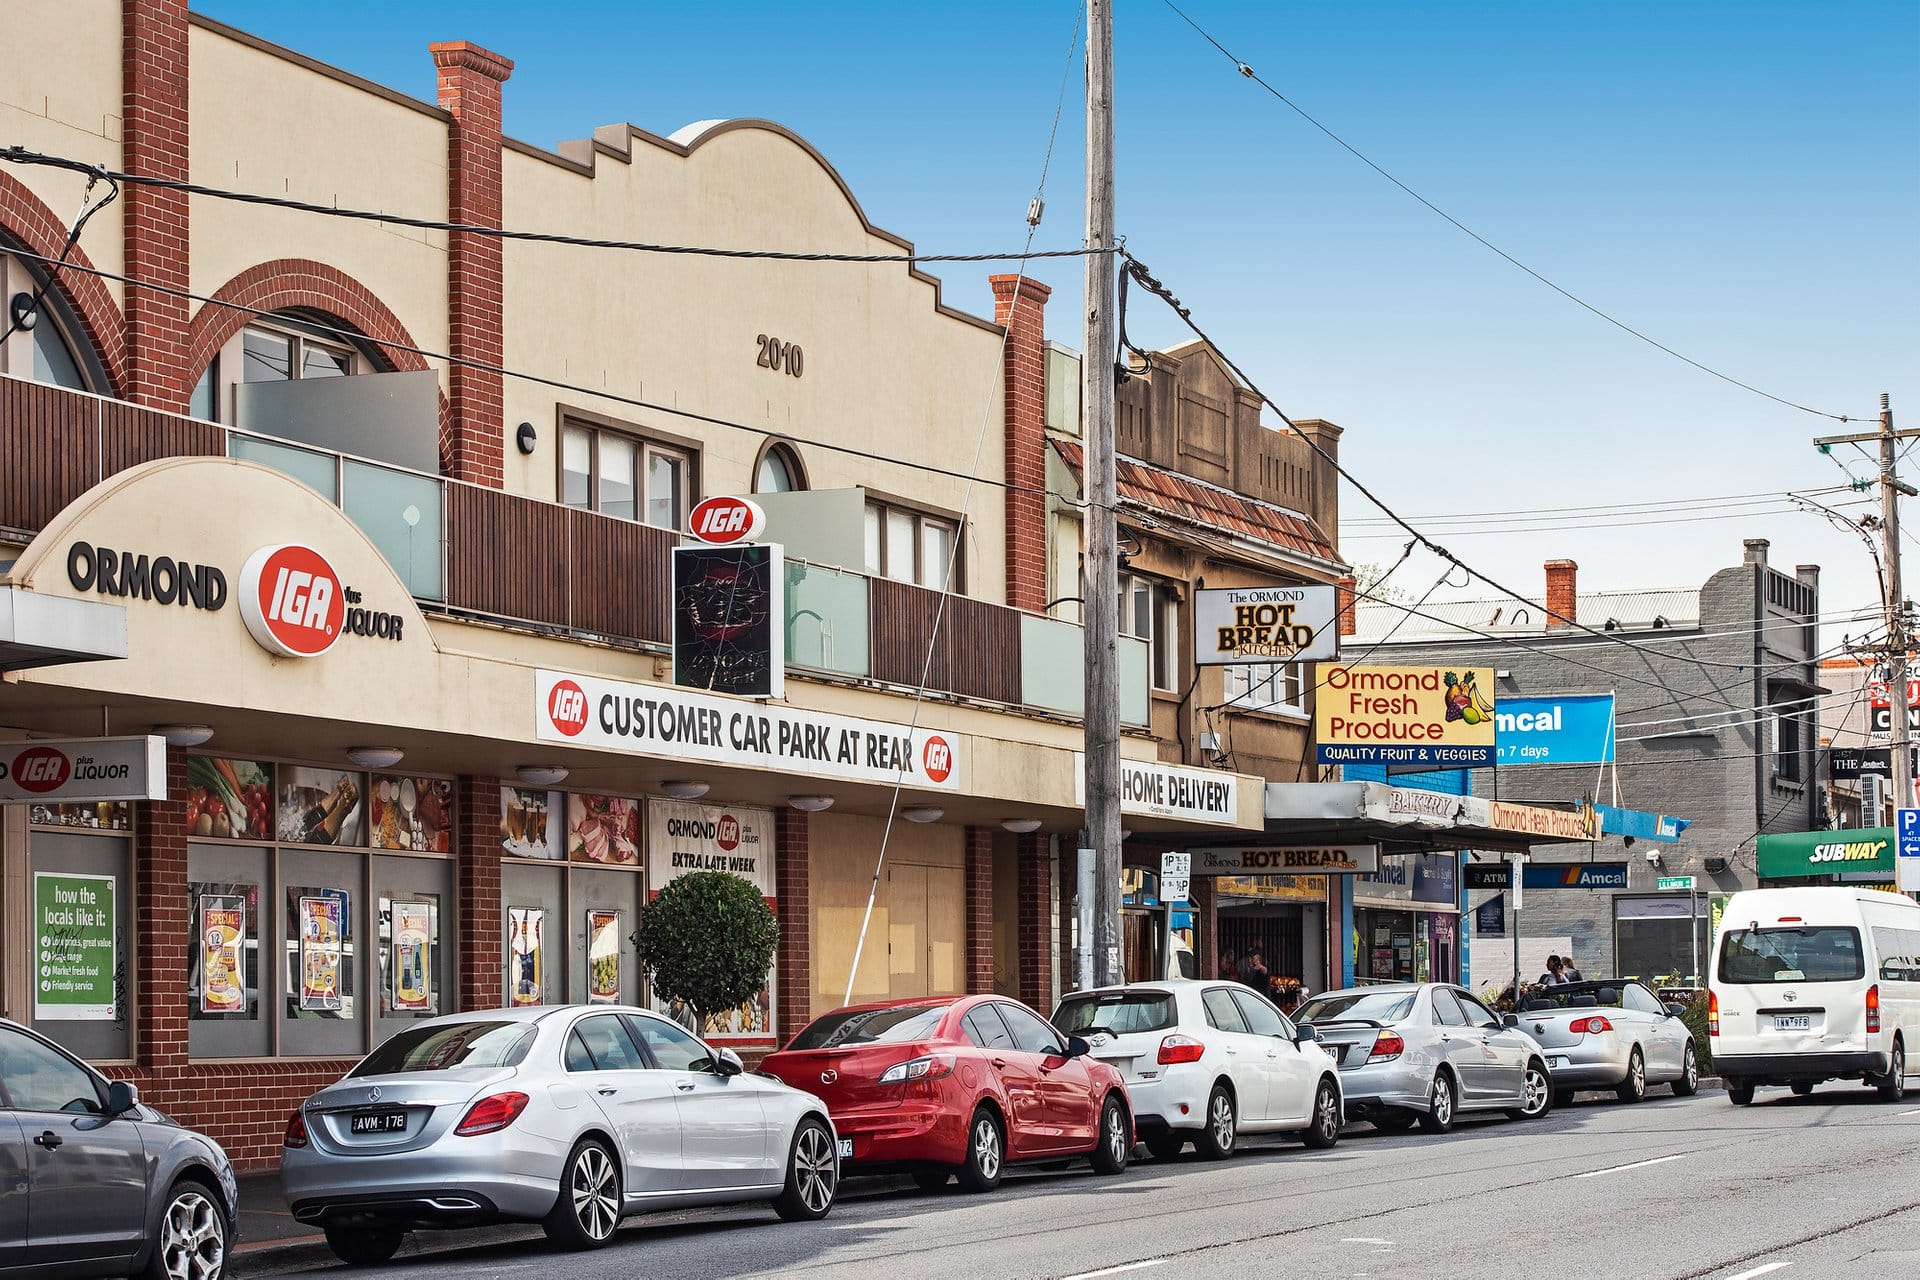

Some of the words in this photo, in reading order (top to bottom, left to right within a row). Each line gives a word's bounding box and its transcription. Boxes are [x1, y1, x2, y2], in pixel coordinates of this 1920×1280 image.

[757, 333, 803, 378] 2010
[700, 507, 747, 534] IGA
[67, 541, 227, 611] ORMOND
[268, 567, 333, 632] IGA
[1227, 592, 1247, 603] The
[1249, 591, 1305, 602] ORMOND
[342, 607, 403, 641] IQUOR
[1235, 604, 1296, 627] HOT
[1217, 625, 1314, 652] BREAD
[1241, 643, 1297, 656] KITCHEN
[1327, 667, 1439, 691] Ormond
[1350, 693, 1418, 715] Fresh
[1331, 717, 1444, 740] Produce
[1496, 706, 1562, 732] mcal
[552, 688, 583, 724] IGA
[599, 694, 723, 747] CUSTOMER
[729, 712, 772, 754] CAR
[778, 719, 831, 762] PARK
[837, 729, 860, 765] AT
[866, 733, 913, 773] REAR
[925, 743, 948, 772] IGA
[76, 756, 94, 765] plus
[1325, 746, 1377, 760] QUALITY
[1380, 748, 1415, 760] FRUIT
[1418, 748, 1429, 760] &
[1434, 749, 1487, 760] VEGGIES
[1509, 746, 1517, 757] 7
[1521, 745, 1549, 759] days
[20, 757, 62, 782] IGA
[74, 765, 129, 780] LIQUOR
[1833, 759, 1858, 769] THE
[1122, 768, 1164, 805] HOME
[1168, 775, 1230, 813] DELIVERY
[1390, 790, 1452, 817] BAKERY
[667, 818, 716, 840] ORMOND
[718, 821, 738, 842] IGA
[1493, 803, 1527, 831] Ormond
[1529, 807, 1550, 834] Fresh
[1551, 810, 1584, 837] Produce
[1905, 811, 1917, 830] P
[741, 834, 759, 844] LIQUOR
[672, 852, 703, 869] EXTRA
[705, 855, 727, 870] LATE
[729, 856, 756, 872] WEEK
[1241, 850, 1280, 868] HOT
[1283, 849, 1348, 867] BREAD
[1808, 839, 1887, 864] SUBWAY
[1483, 873, 1507, 883] ATM
[1580, 871, 1626, 885] Amcal
[55, 885, 77, 904] how
[80, 886, 96, 905] the
[45, 907, 73, 925] locals
[76, 908, 93, 926] like
[96, 908, 106, 926] it:
[83, 938, 97, 949] great
[97, 937, 112, 948] value
[72, 966, 86, 976] fresh
[87, 966, 99, 976] food
[52, 980, 74, 992] Friendly
[75, 981, 94, 991] service
